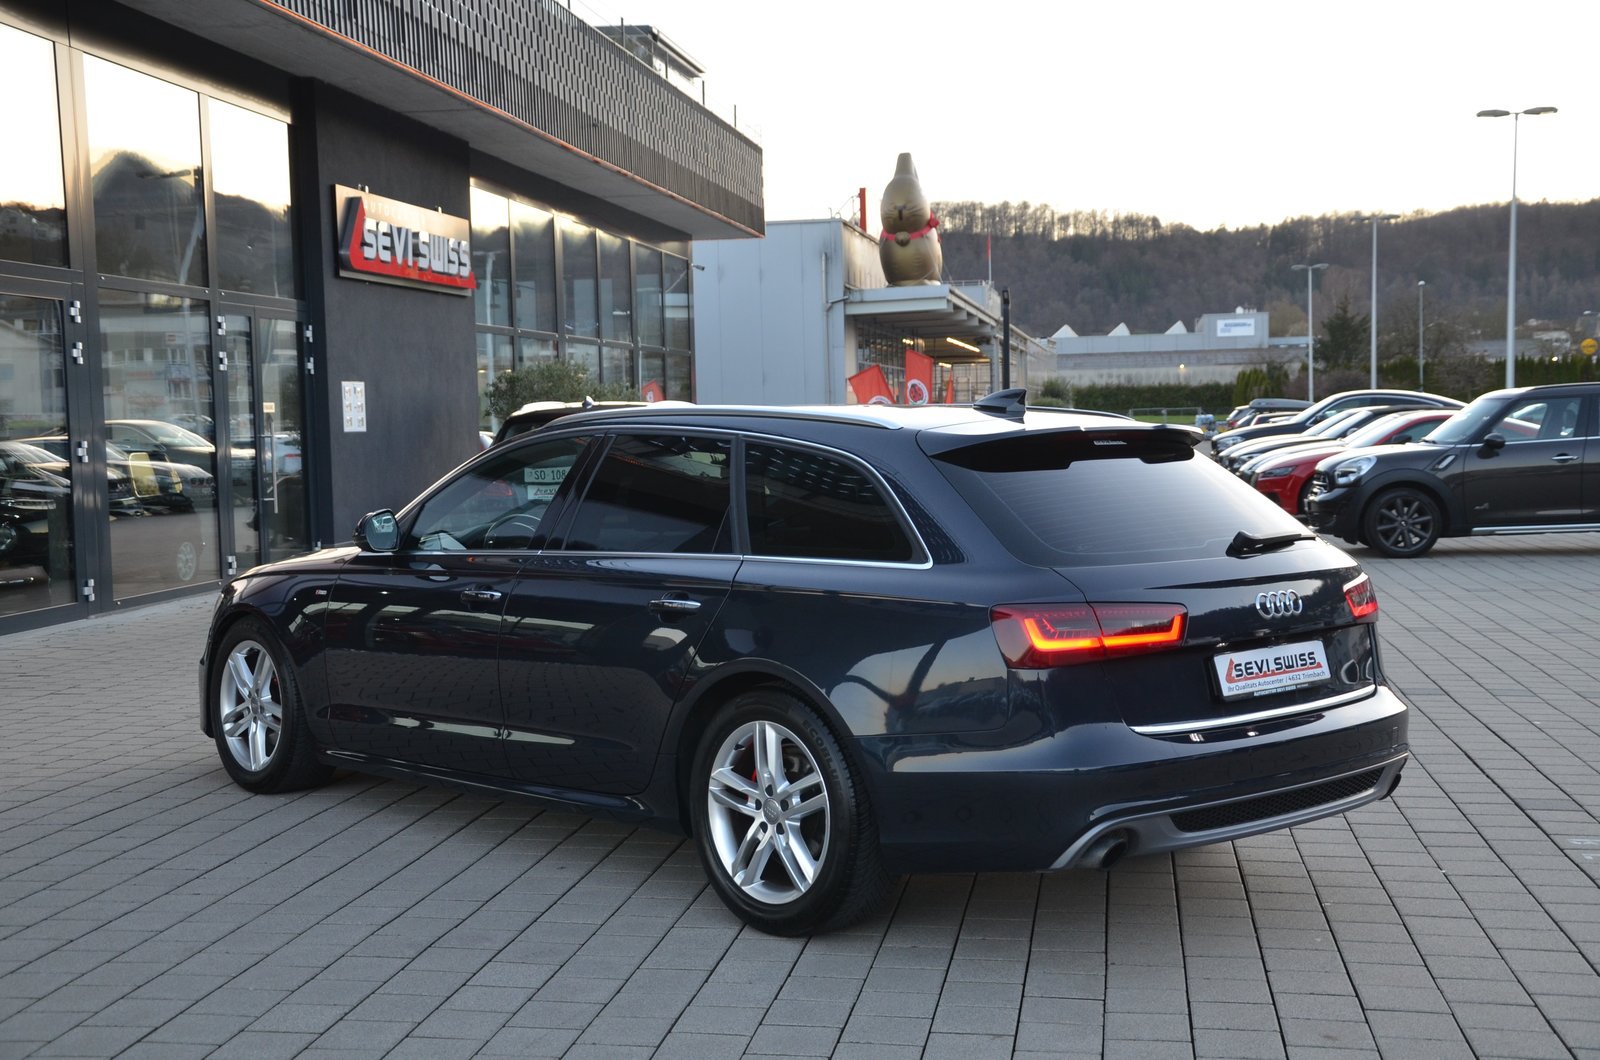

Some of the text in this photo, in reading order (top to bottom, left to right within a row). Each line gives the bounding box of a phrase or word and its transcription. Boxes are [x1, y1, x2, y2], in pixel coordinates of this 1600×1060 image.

[363, 217, 471, 279] SEVI SWISS
[1234, 651, 1317, 678] SEVI SWISS
[1258, 678, 1284, 687] Autocenter
[1288, 673, 1301, 681] 4632
[1302, 670, 1326, 679] Trimbach
